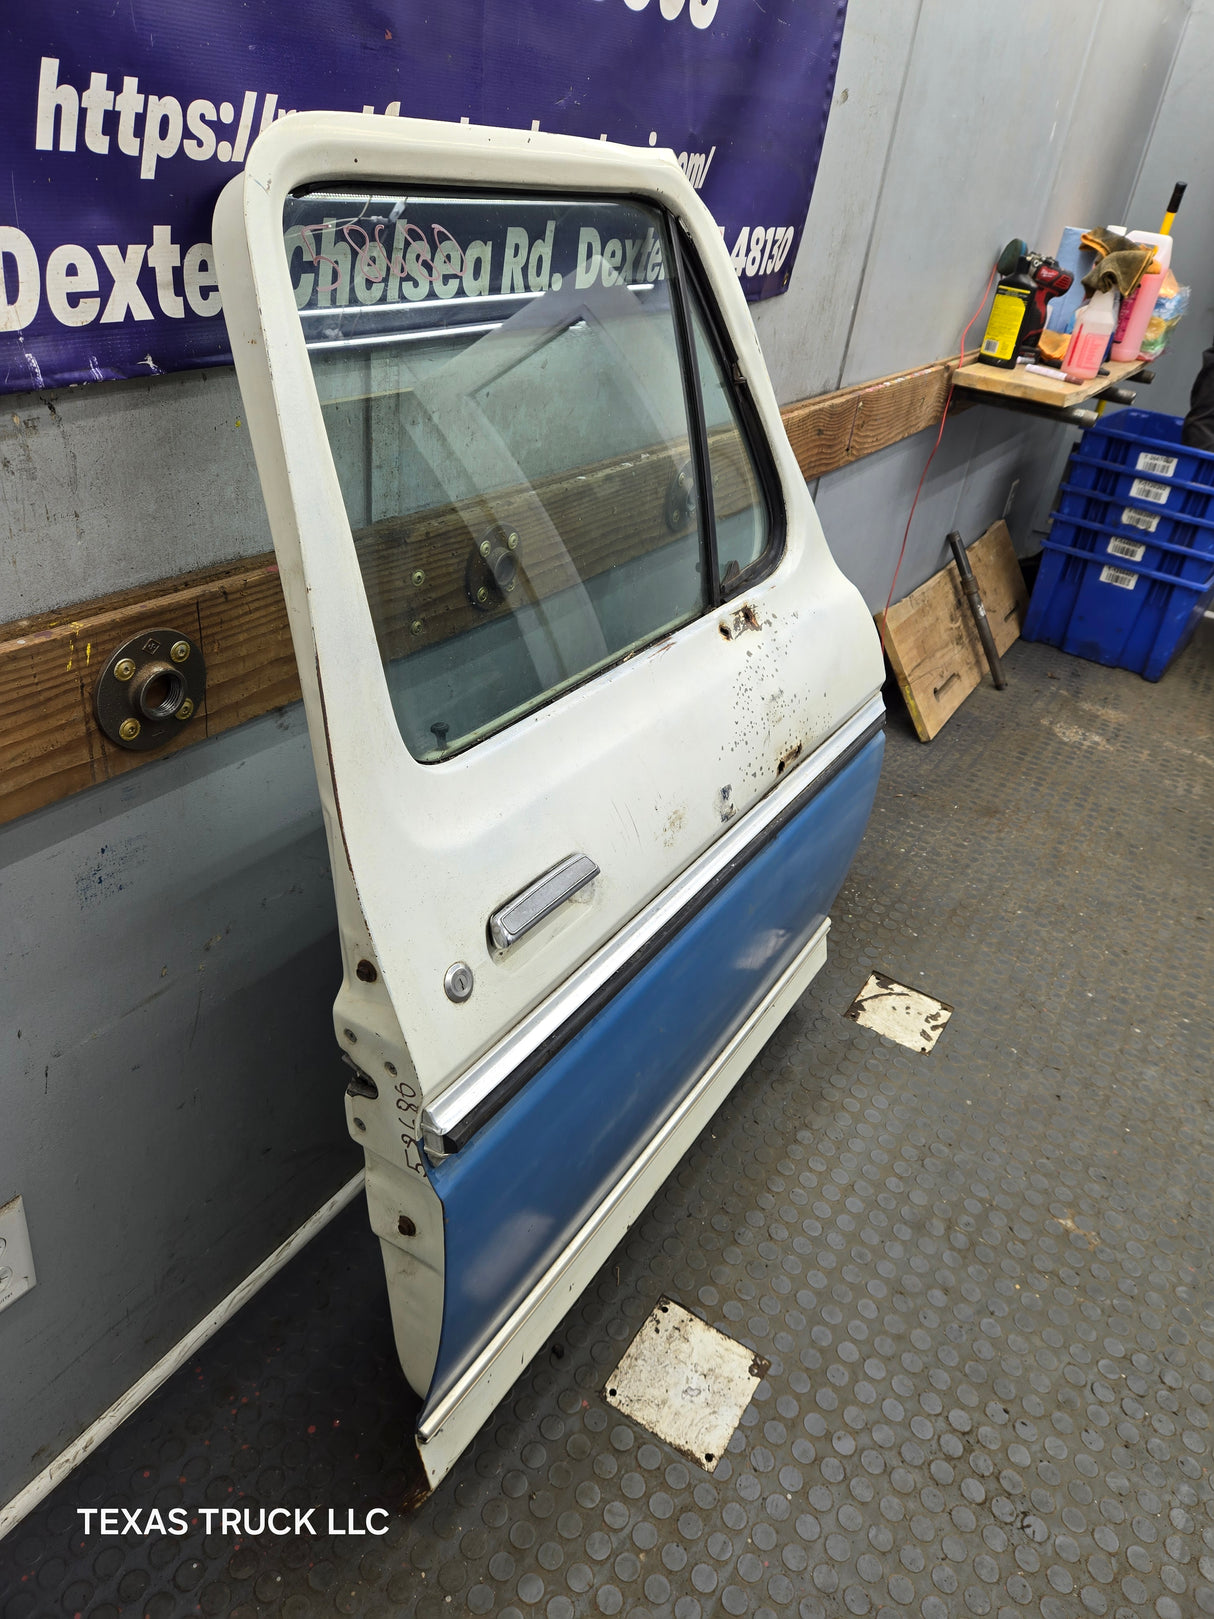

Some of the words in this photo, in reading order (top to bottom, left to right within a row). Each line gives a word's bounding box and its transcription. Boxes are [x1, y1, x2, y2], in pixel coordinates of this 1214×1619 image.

[0, 225, 223, 333] Dexte
[283, 217, 493, 309] Chelsea
[501, 220, 563, 294] Rd.
[730, 226, 795, 277] 48130
